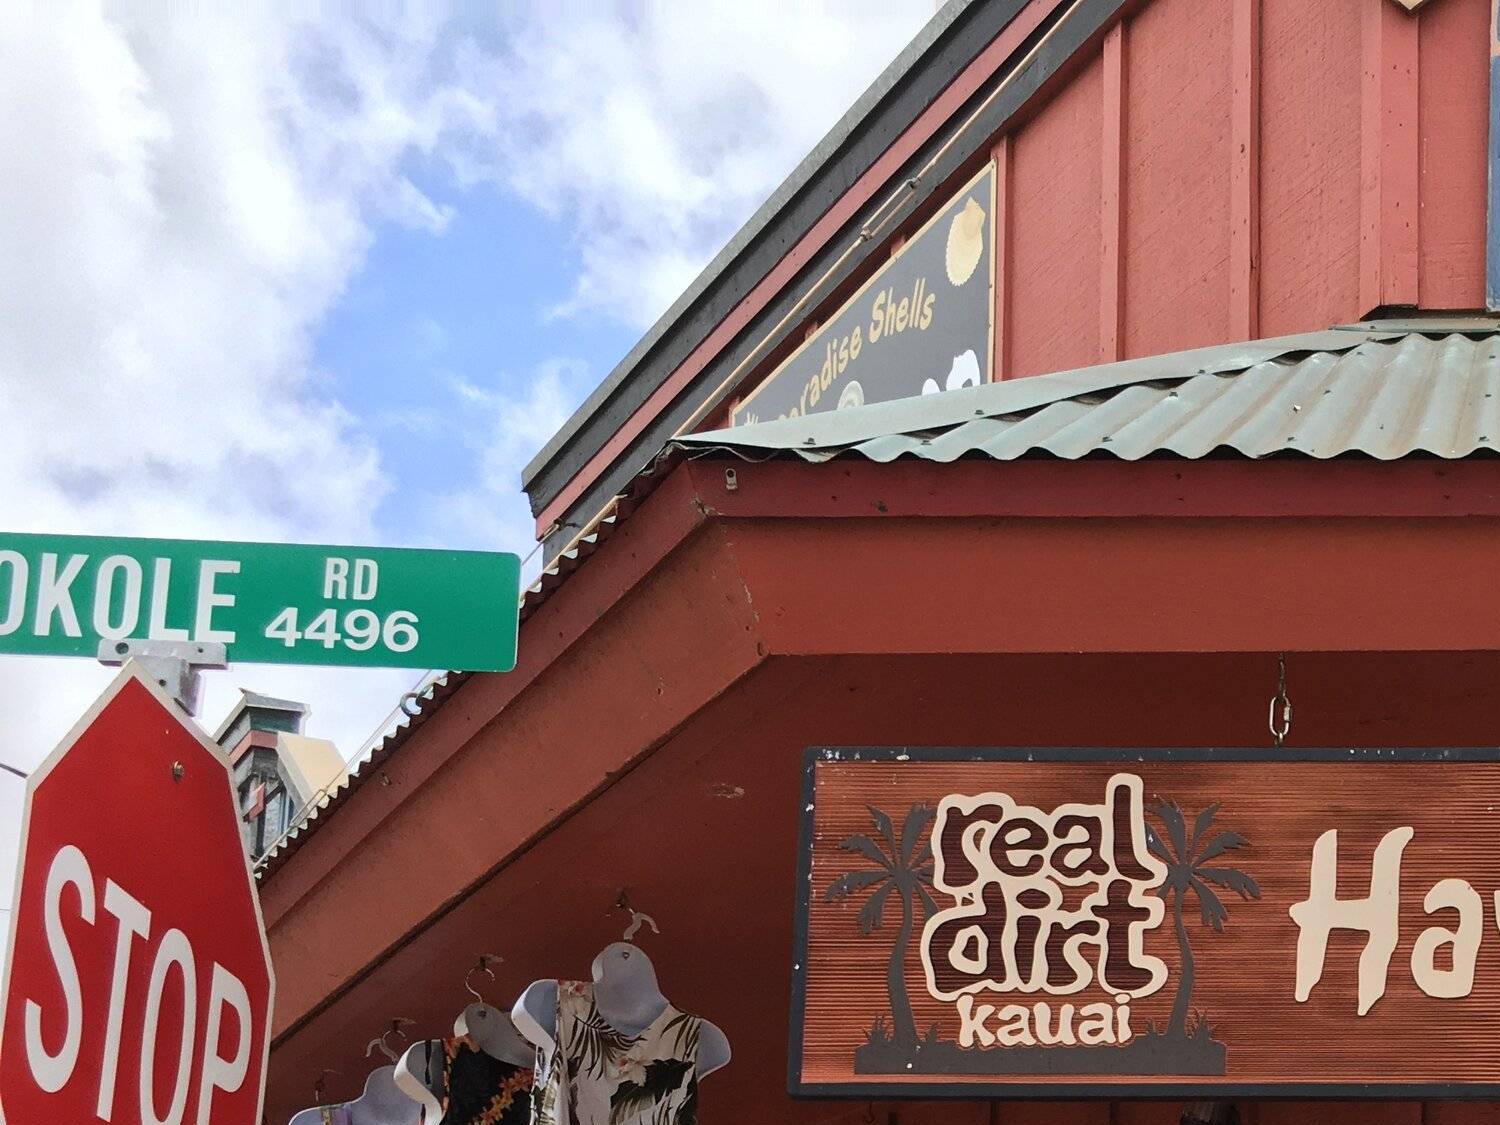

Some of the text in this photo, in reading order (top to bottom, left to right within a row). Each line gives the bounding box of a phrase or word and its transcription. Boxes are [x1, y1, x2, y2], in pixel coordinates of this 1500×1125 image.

[869, 278, 936, 343] Shells
[323, 557, 379, 601] RD
[264, 607, 420, 652] 4496
[931, 773, 1168, 893] real
[920, 878, 1169, 1001] dirt
[957, 994, 1133, 1048] kauai
